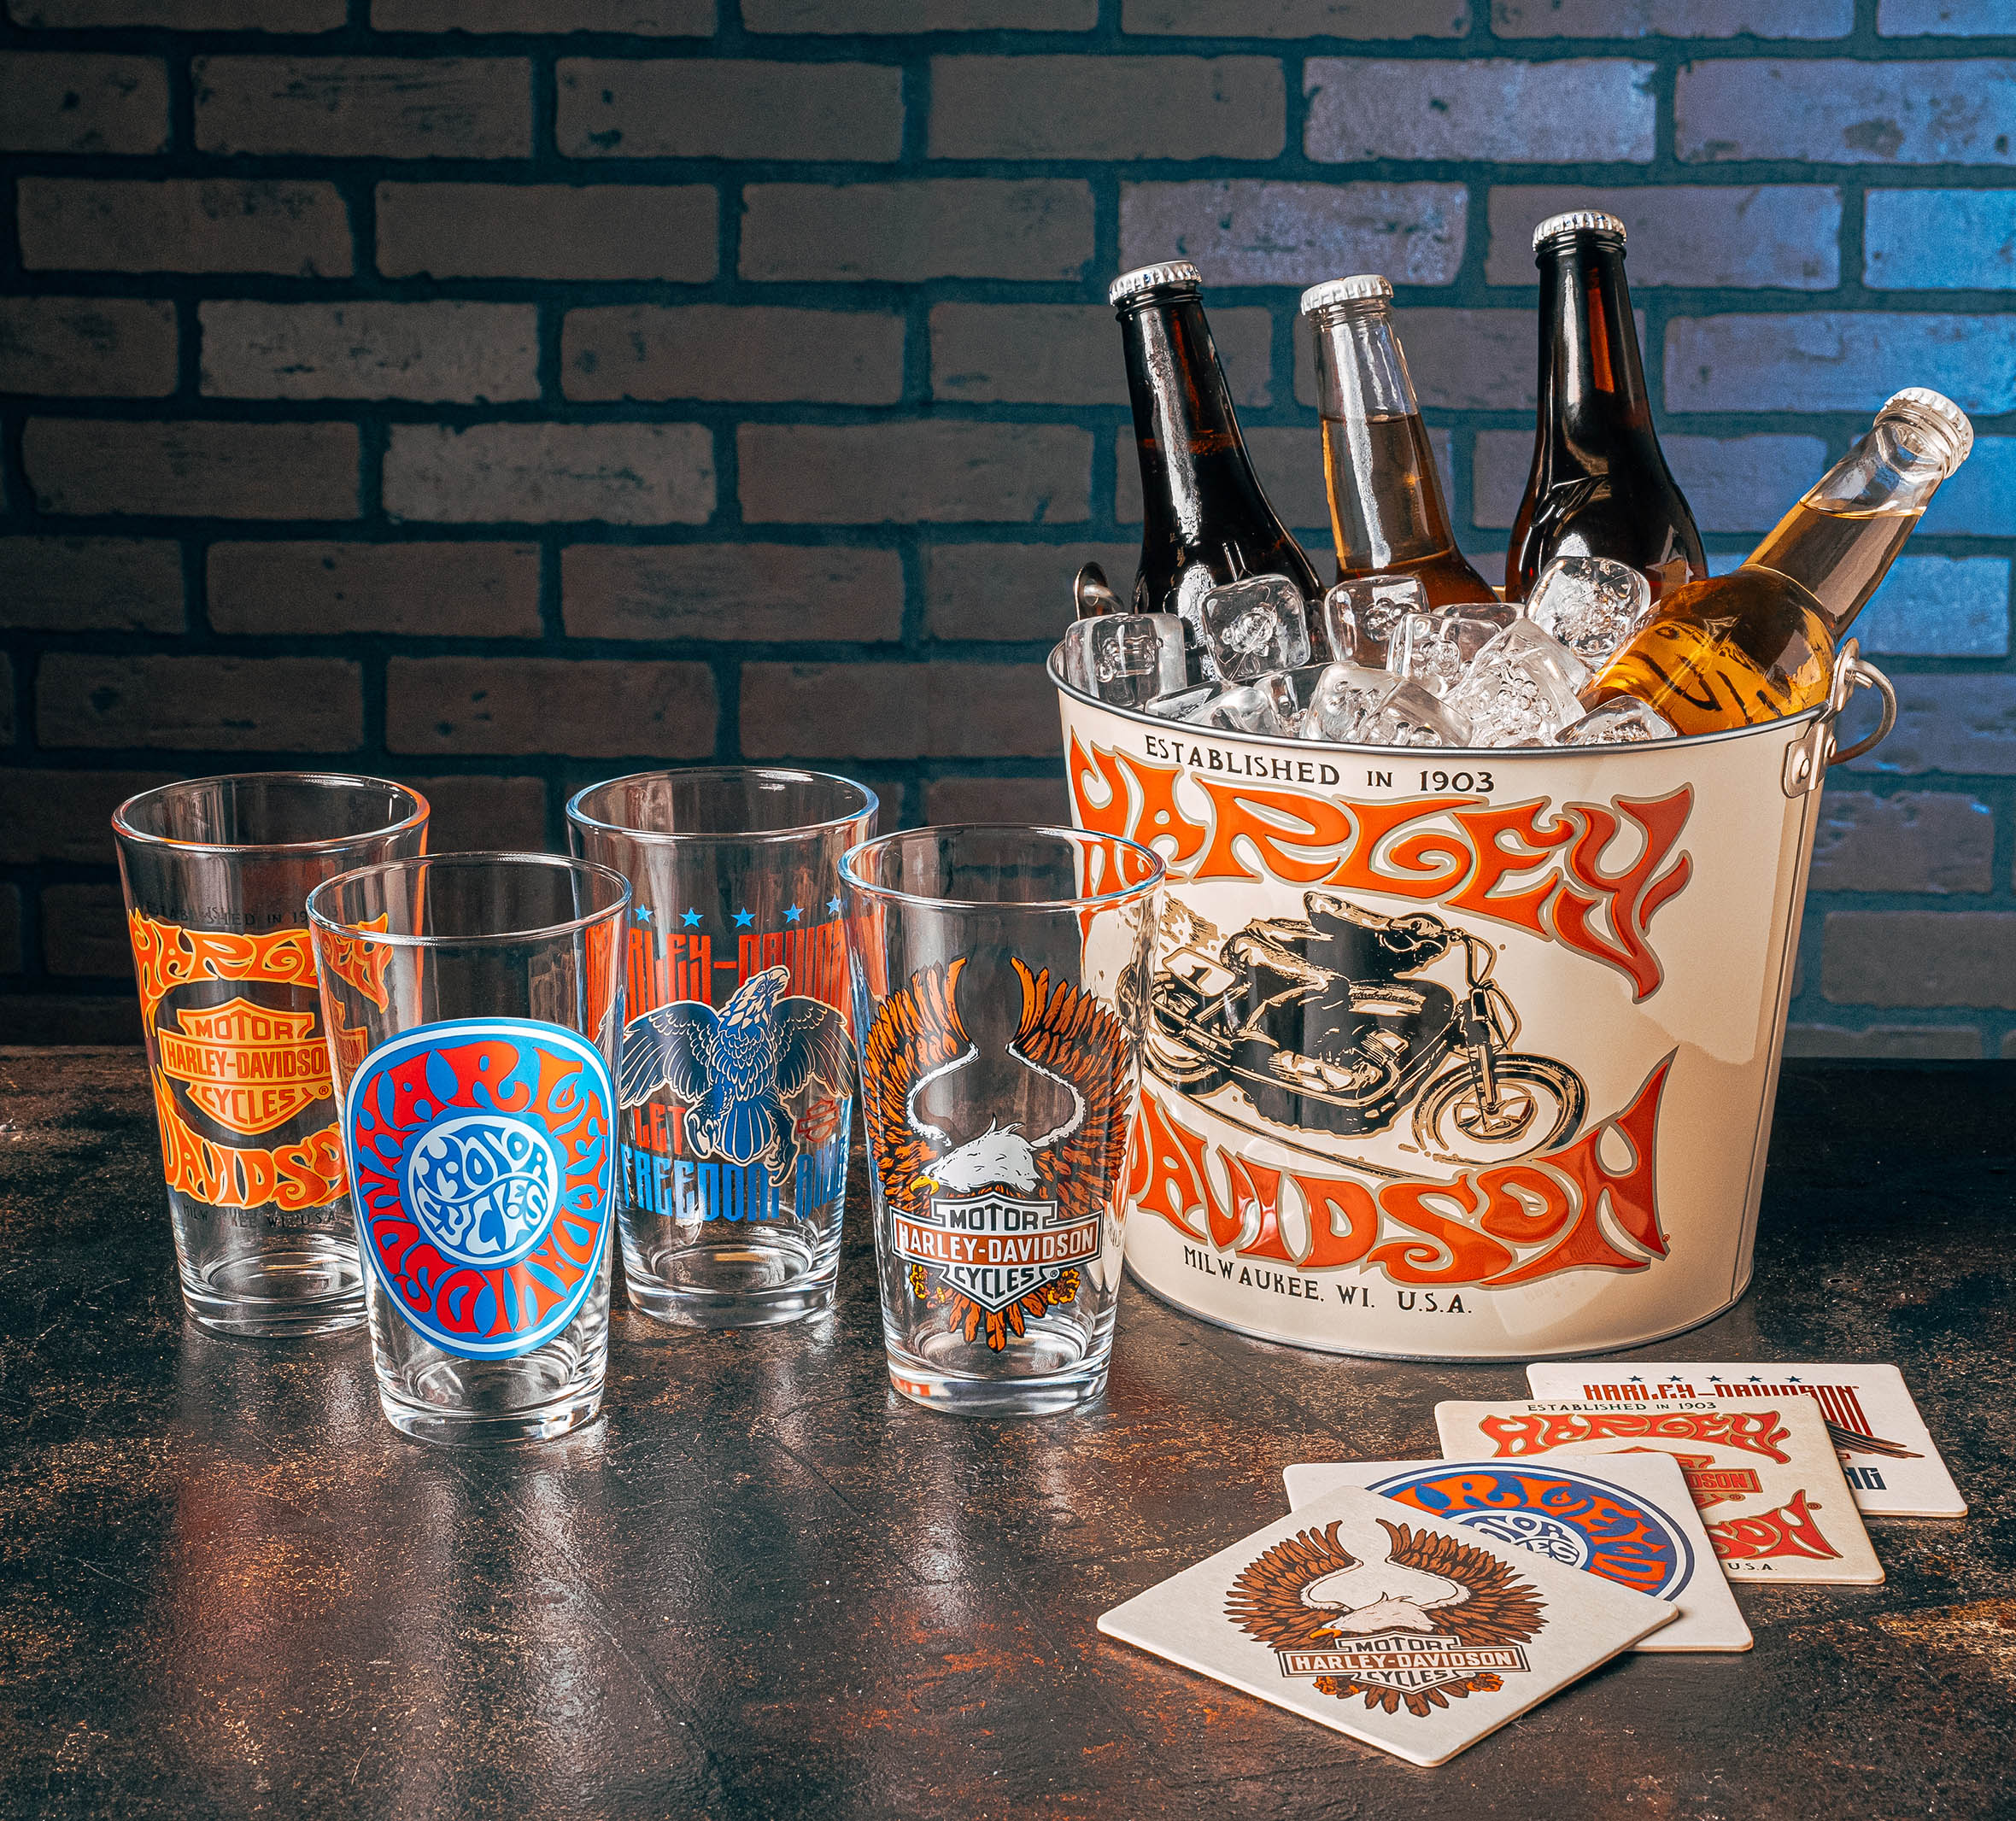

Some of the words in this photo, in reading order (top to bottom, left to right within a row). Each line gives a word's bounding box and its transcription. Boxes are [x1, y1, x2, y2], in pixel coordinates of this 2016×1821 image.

[1145, 735, 1340, 785] ESTABLISHED
[1367, 770, 1393, 787] IN
[1420, 770, 1496, 793] 1903
[1070, 724, 1695, 1004] HARLEY
[196, 1011, 299, 1040] MOTOR
[202, 1085, 297, 1127] CYCLES
[634, 1101, 686, 1156] LET
[419, 1123, 550, 1198] MOTOR
[621, 1142, 780, 1223] FREEDOM
[950, 1202, 1039, 1231] MOTOR
[898, 1222, 1095, 1263] HARLEY-DAVIDSON
[953, 1267, 1035, 1300] CYCLES
[1183, 1244, 1325, 1303] MILWAUKEE.
[1398, 1291, 1473, 1314] U.S.A.
[1679, 1402, 1717, 1410] 1903
[1479, 1408, 1791, 1465] HARLEY
[1728, 1562, 1779, 1572] U.S.A.
[1294, 1651, 1513, 1672] HARLEY-DAVIDSON
[1356, 1637, 1443, 1652] MOTOR
[1367, 1669, 1450, 1688] CYCLES
